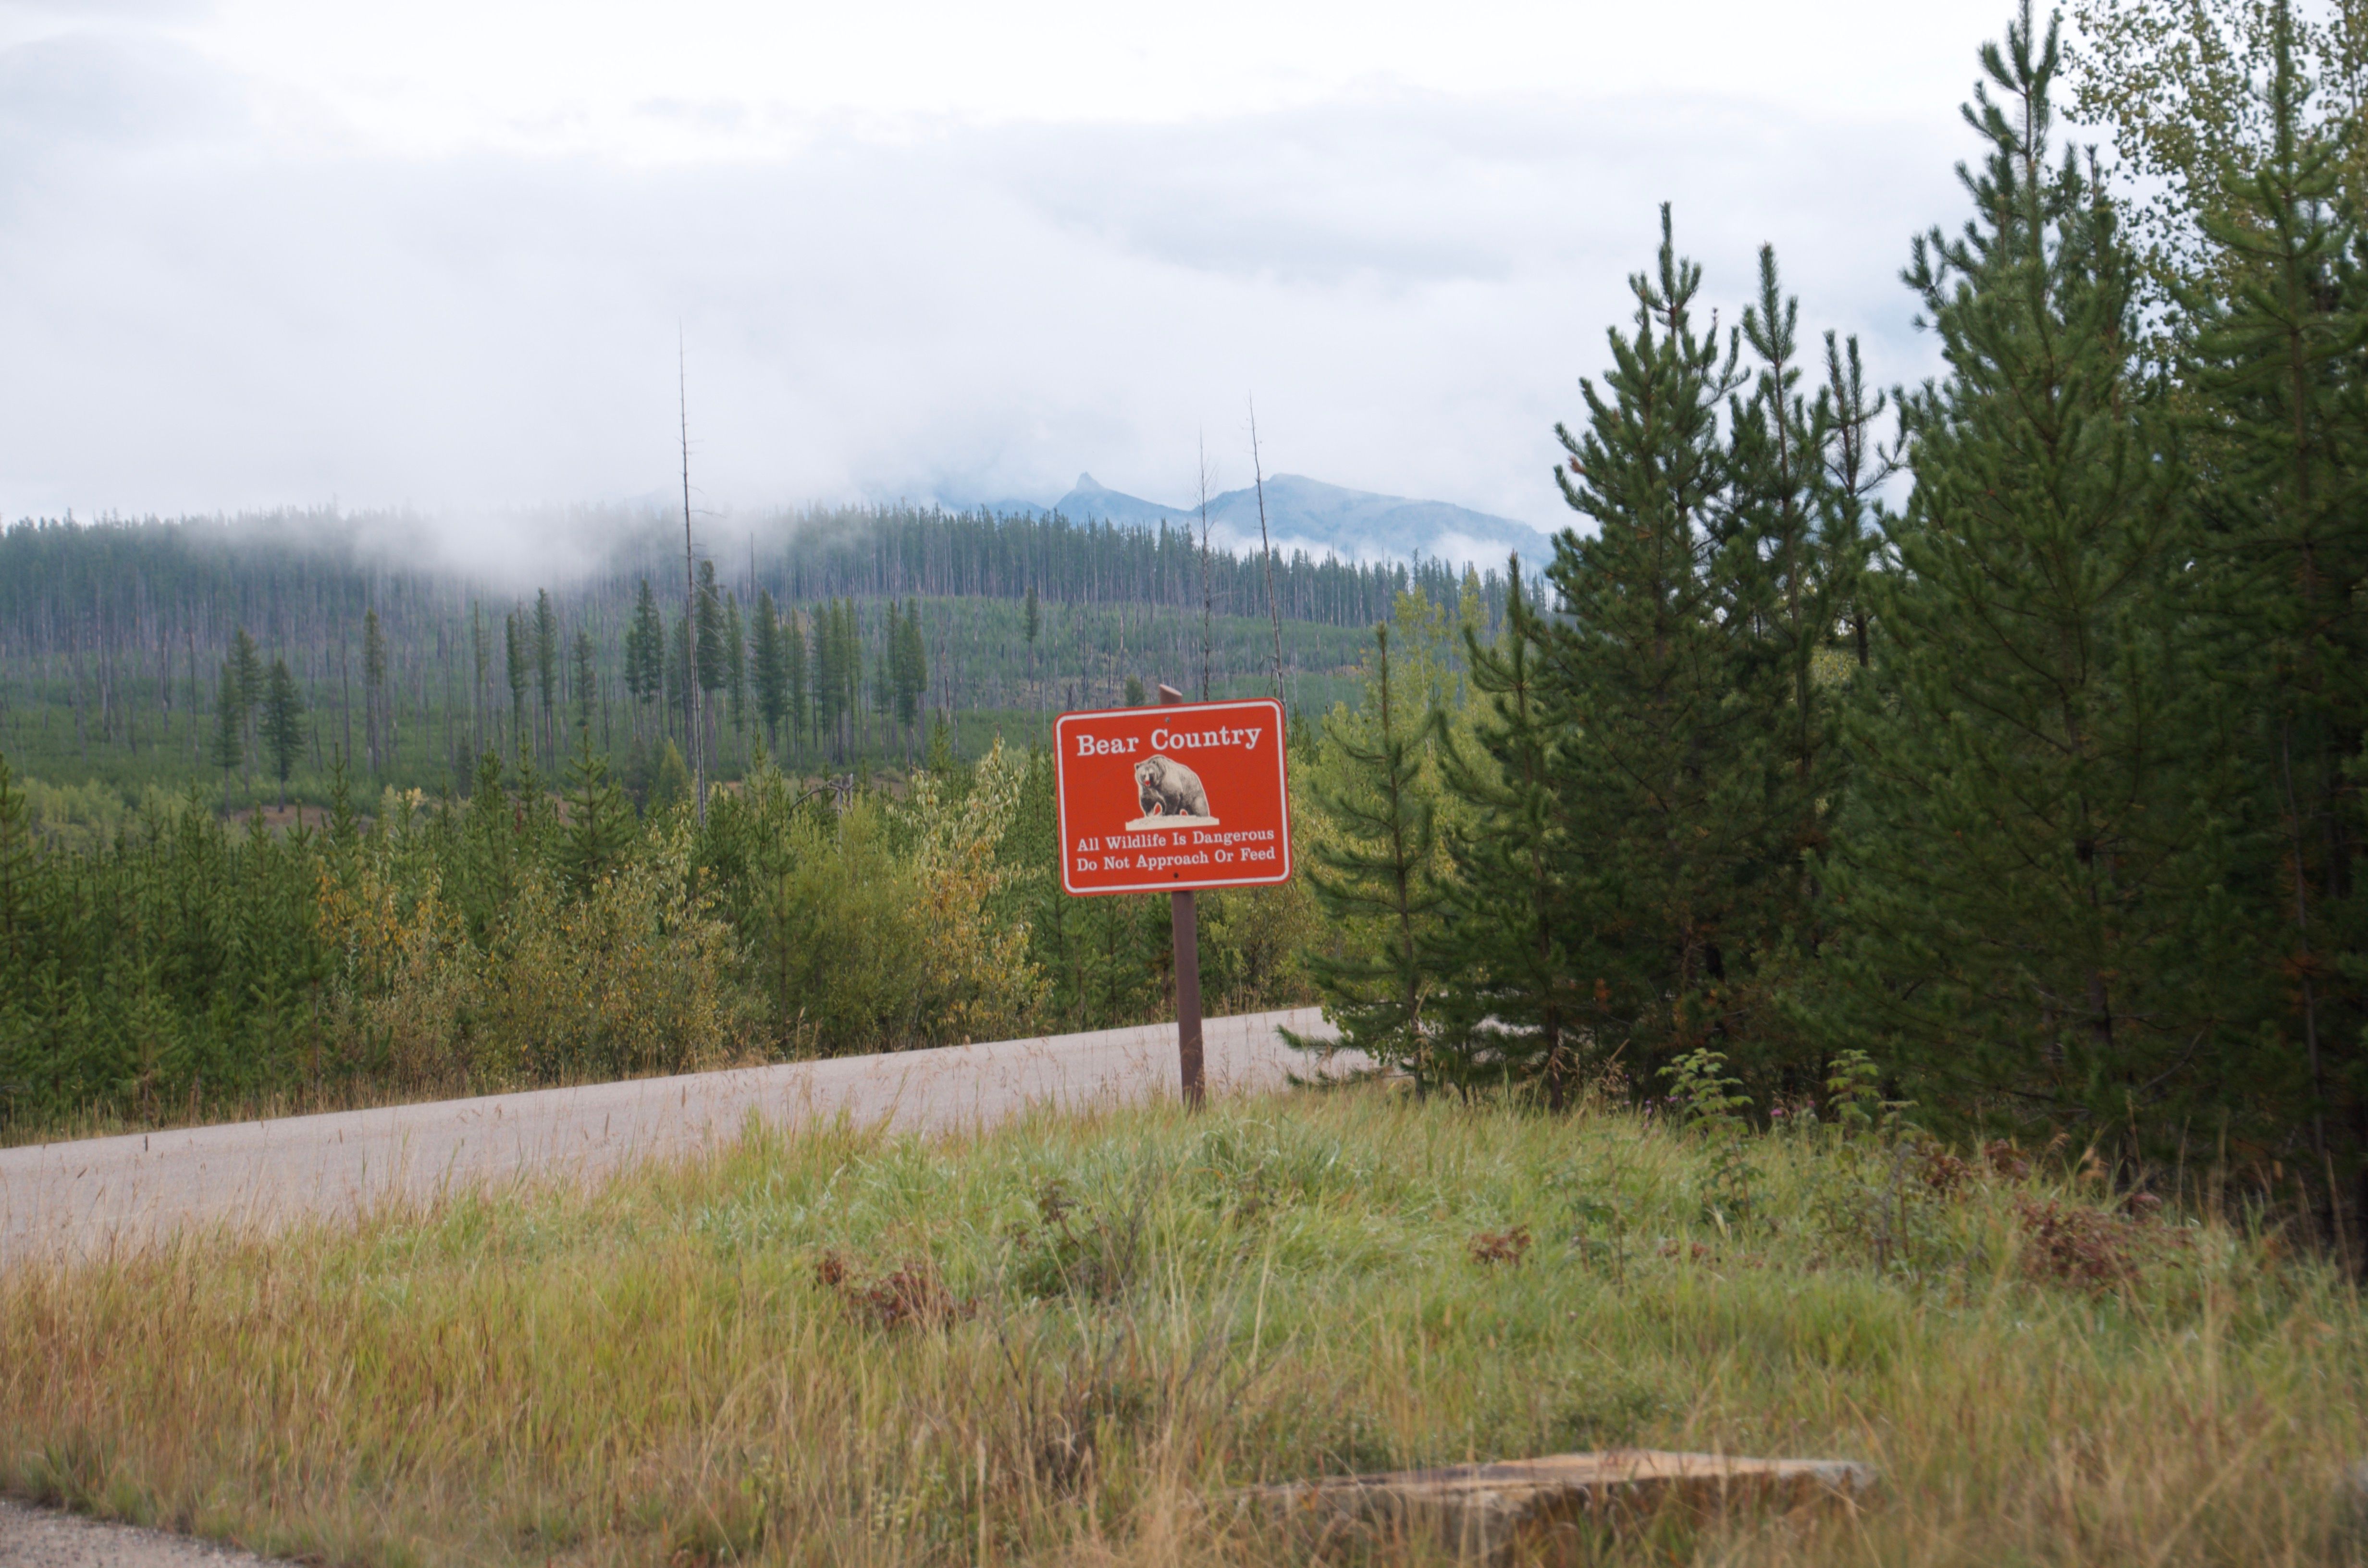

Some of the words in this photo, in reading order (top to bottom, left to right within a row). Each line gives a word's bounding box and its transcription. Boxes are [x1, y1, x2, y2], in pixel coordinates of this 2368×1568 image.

[1076, 735, 1139, 756] Bear
[1151, 725, 1262, 750] Country
[1078, 838, 1099, 851] All
[1106, 834, 1166, 849] Wildlife
[1173, 833, 1186, 845] Is
[1193, 830, 1274, 845] Dangerous
[1077, 858, 1097, 871] Do
[1104, 857, 1130, 870] Not
[1136, 851, 1209, 870] Approach
[1215, 849, 1233, 862] Or
[1241, 846, 1275, 861] Feed
